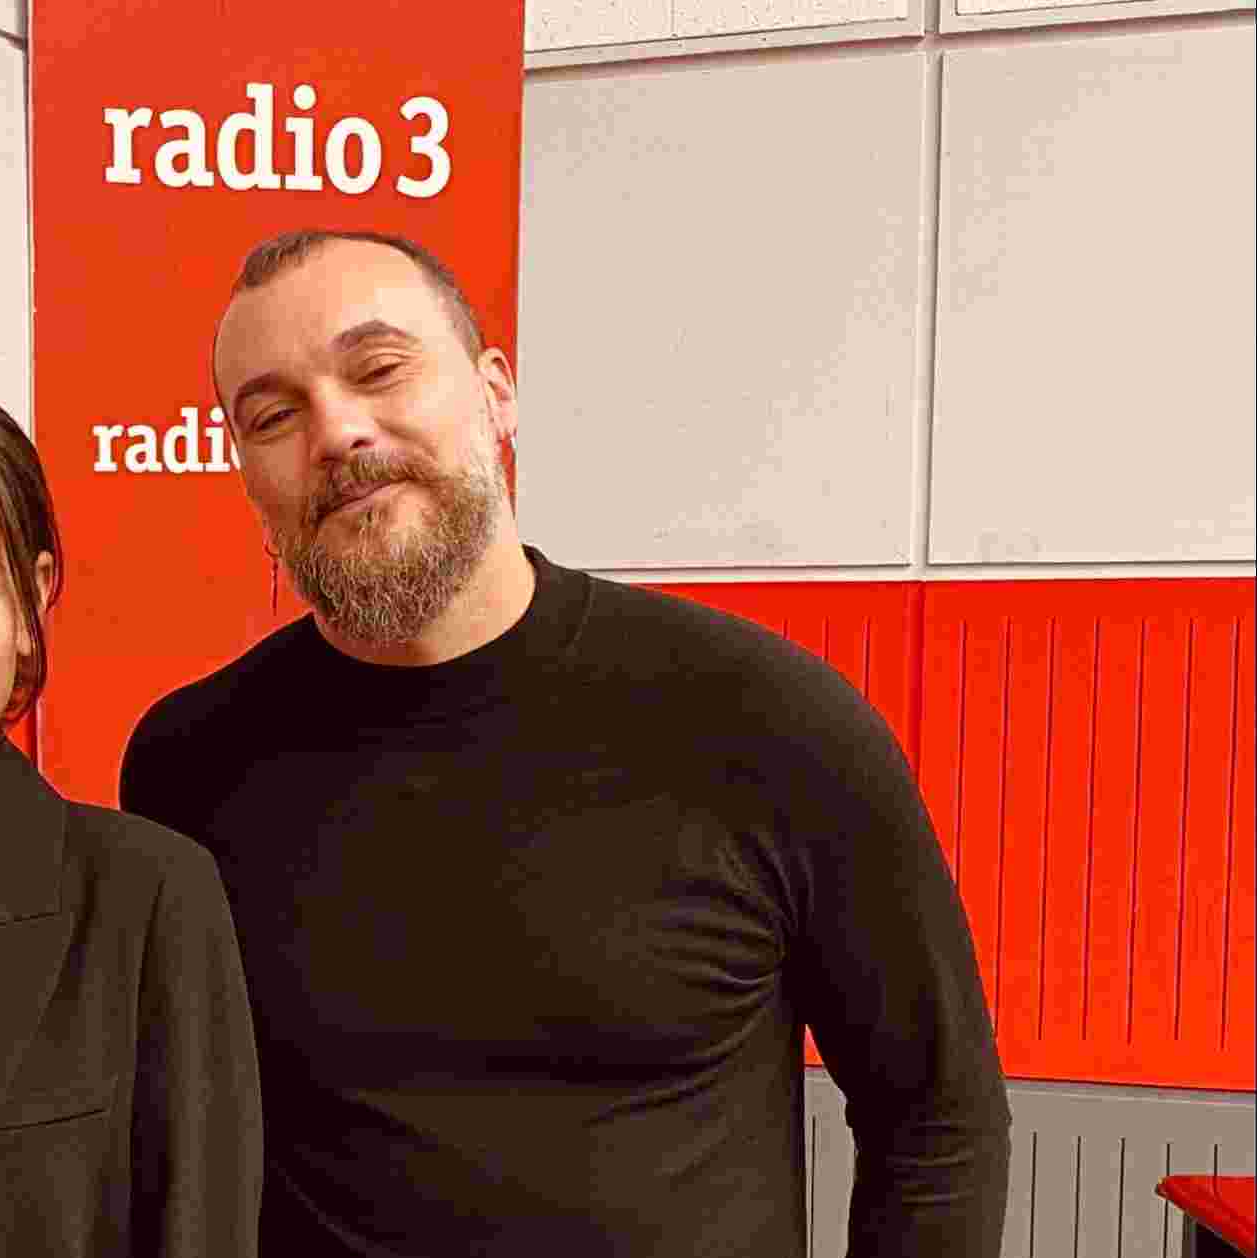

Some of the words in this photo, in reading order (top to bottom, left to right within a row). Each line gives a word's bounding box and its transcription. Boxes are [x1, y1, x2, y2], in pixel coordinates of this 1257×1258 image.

[103, 82, 383, 195] radio
[395, 95, 452, 199] 3
[92, 406, 242, 474] radi
